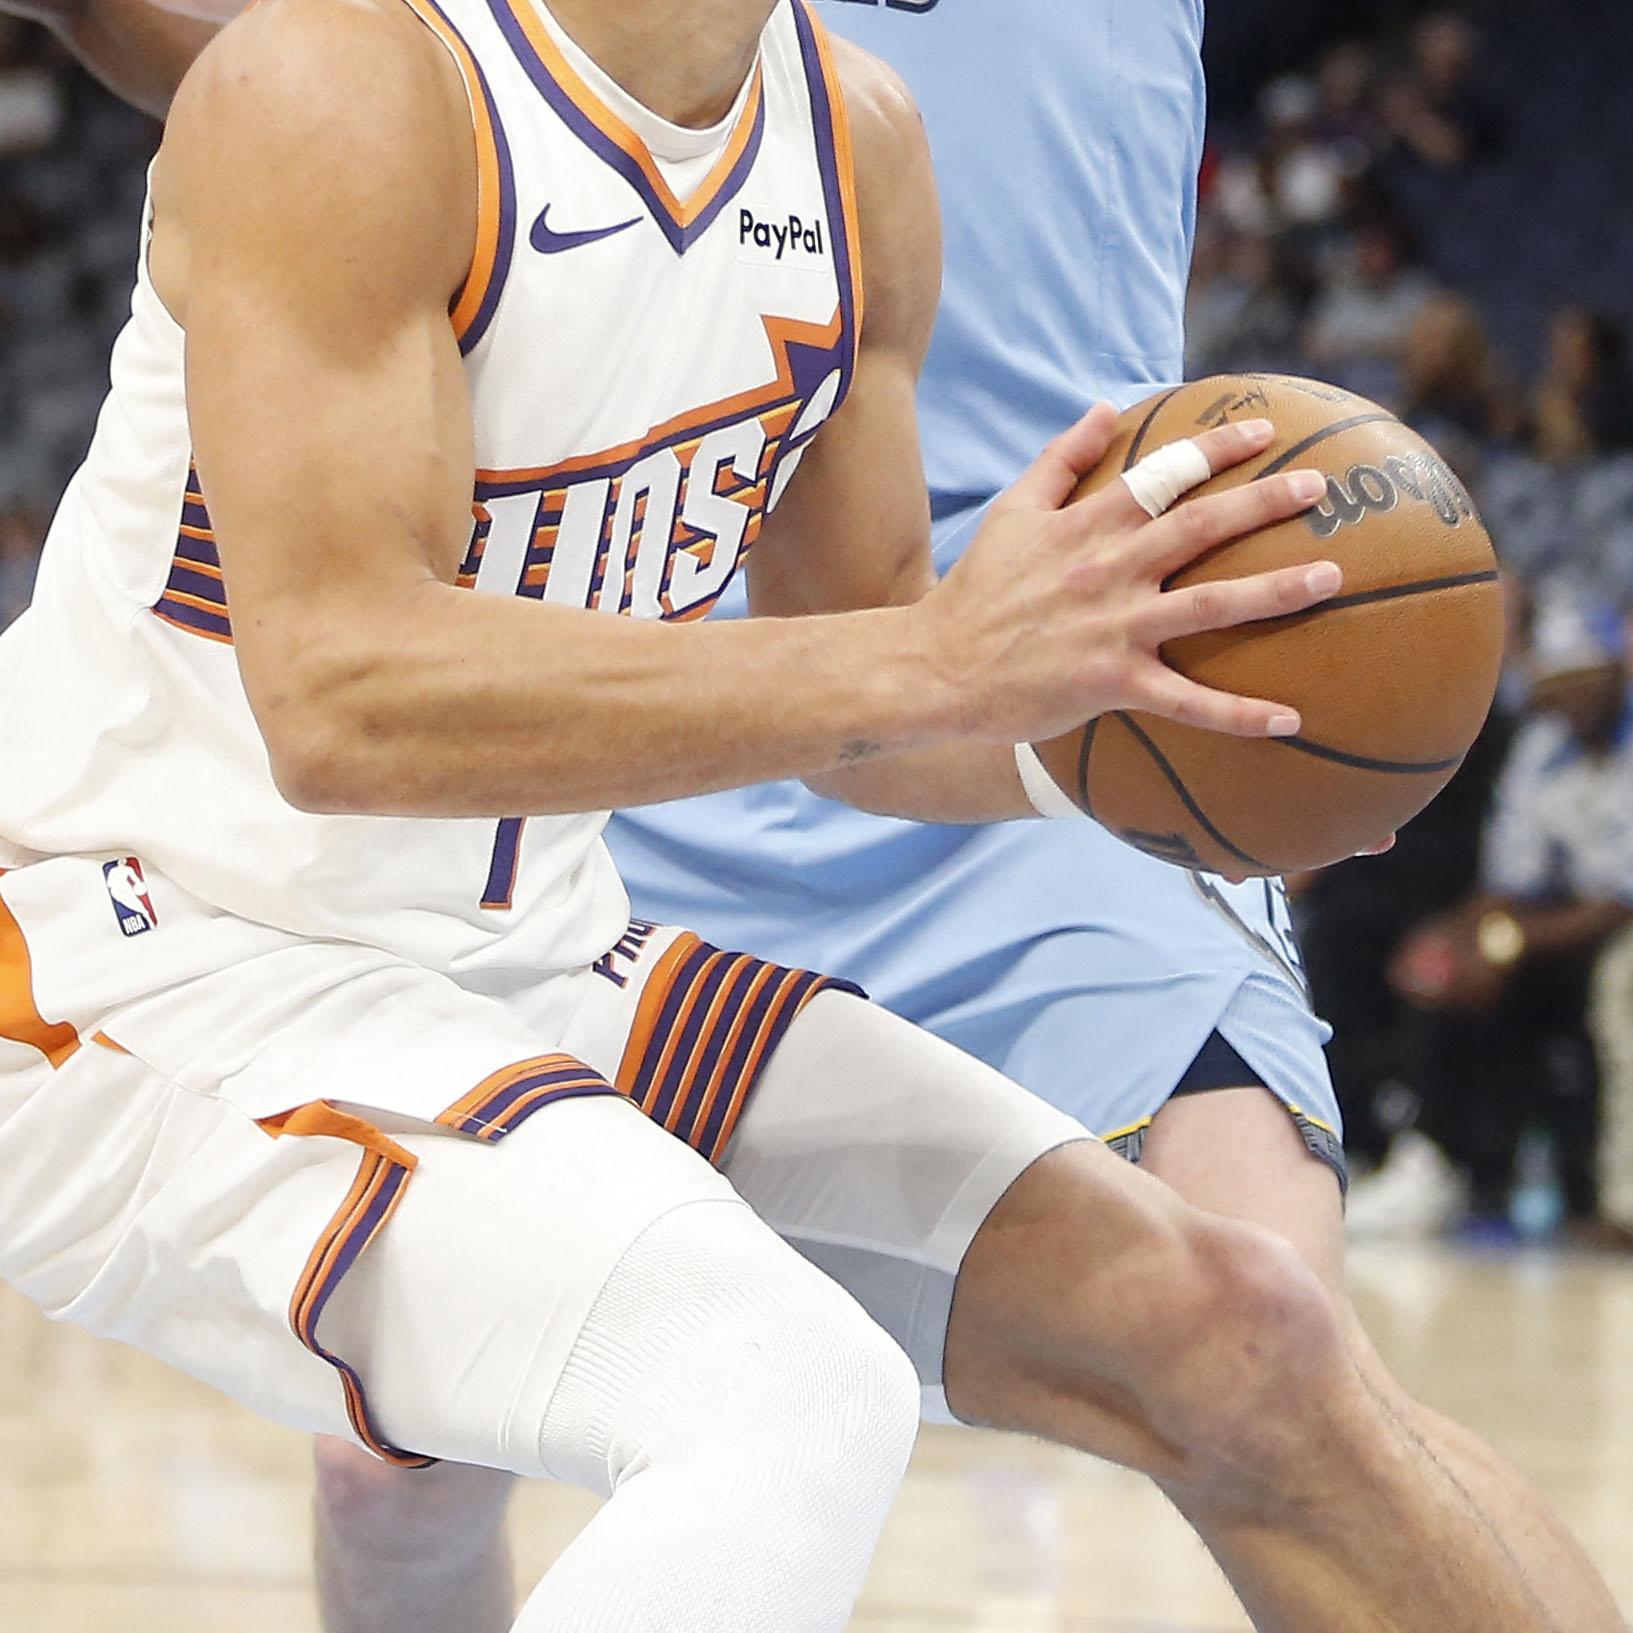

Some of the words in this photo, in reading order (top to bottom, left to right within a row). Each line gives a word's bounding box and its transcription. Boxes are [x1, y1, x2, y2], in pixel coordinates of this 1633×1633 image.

[739, 208, 824, 259] PayPal
[465, 416, 768, 620] UNS
[122, 913, 147, 935] NBA
